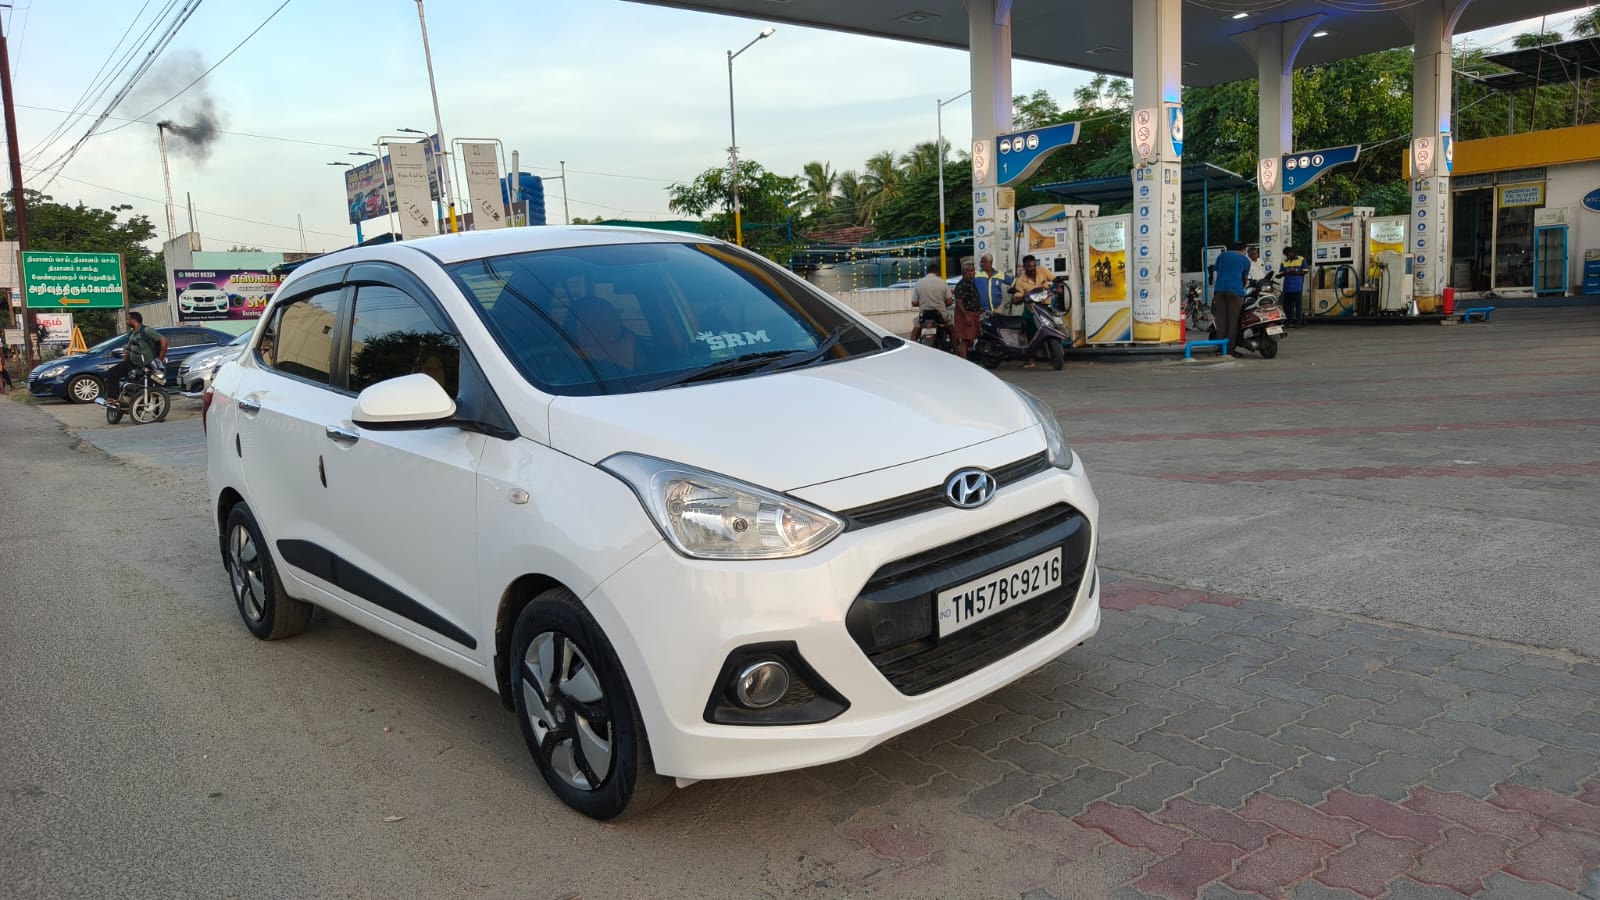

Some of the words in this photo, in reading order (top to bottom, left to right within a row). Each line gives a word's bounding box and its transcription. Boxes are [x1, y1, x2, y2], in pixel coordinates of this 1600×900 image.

[1002, 162, 1008, 174] 1
[1288, 176, 1294, 185] 3
[28, 283, 123, 296] அறிவுத்திருக்கோயில்
[247, 294, 267, 308] SM
[952, 556, 1060, 623] TN57BC9216
